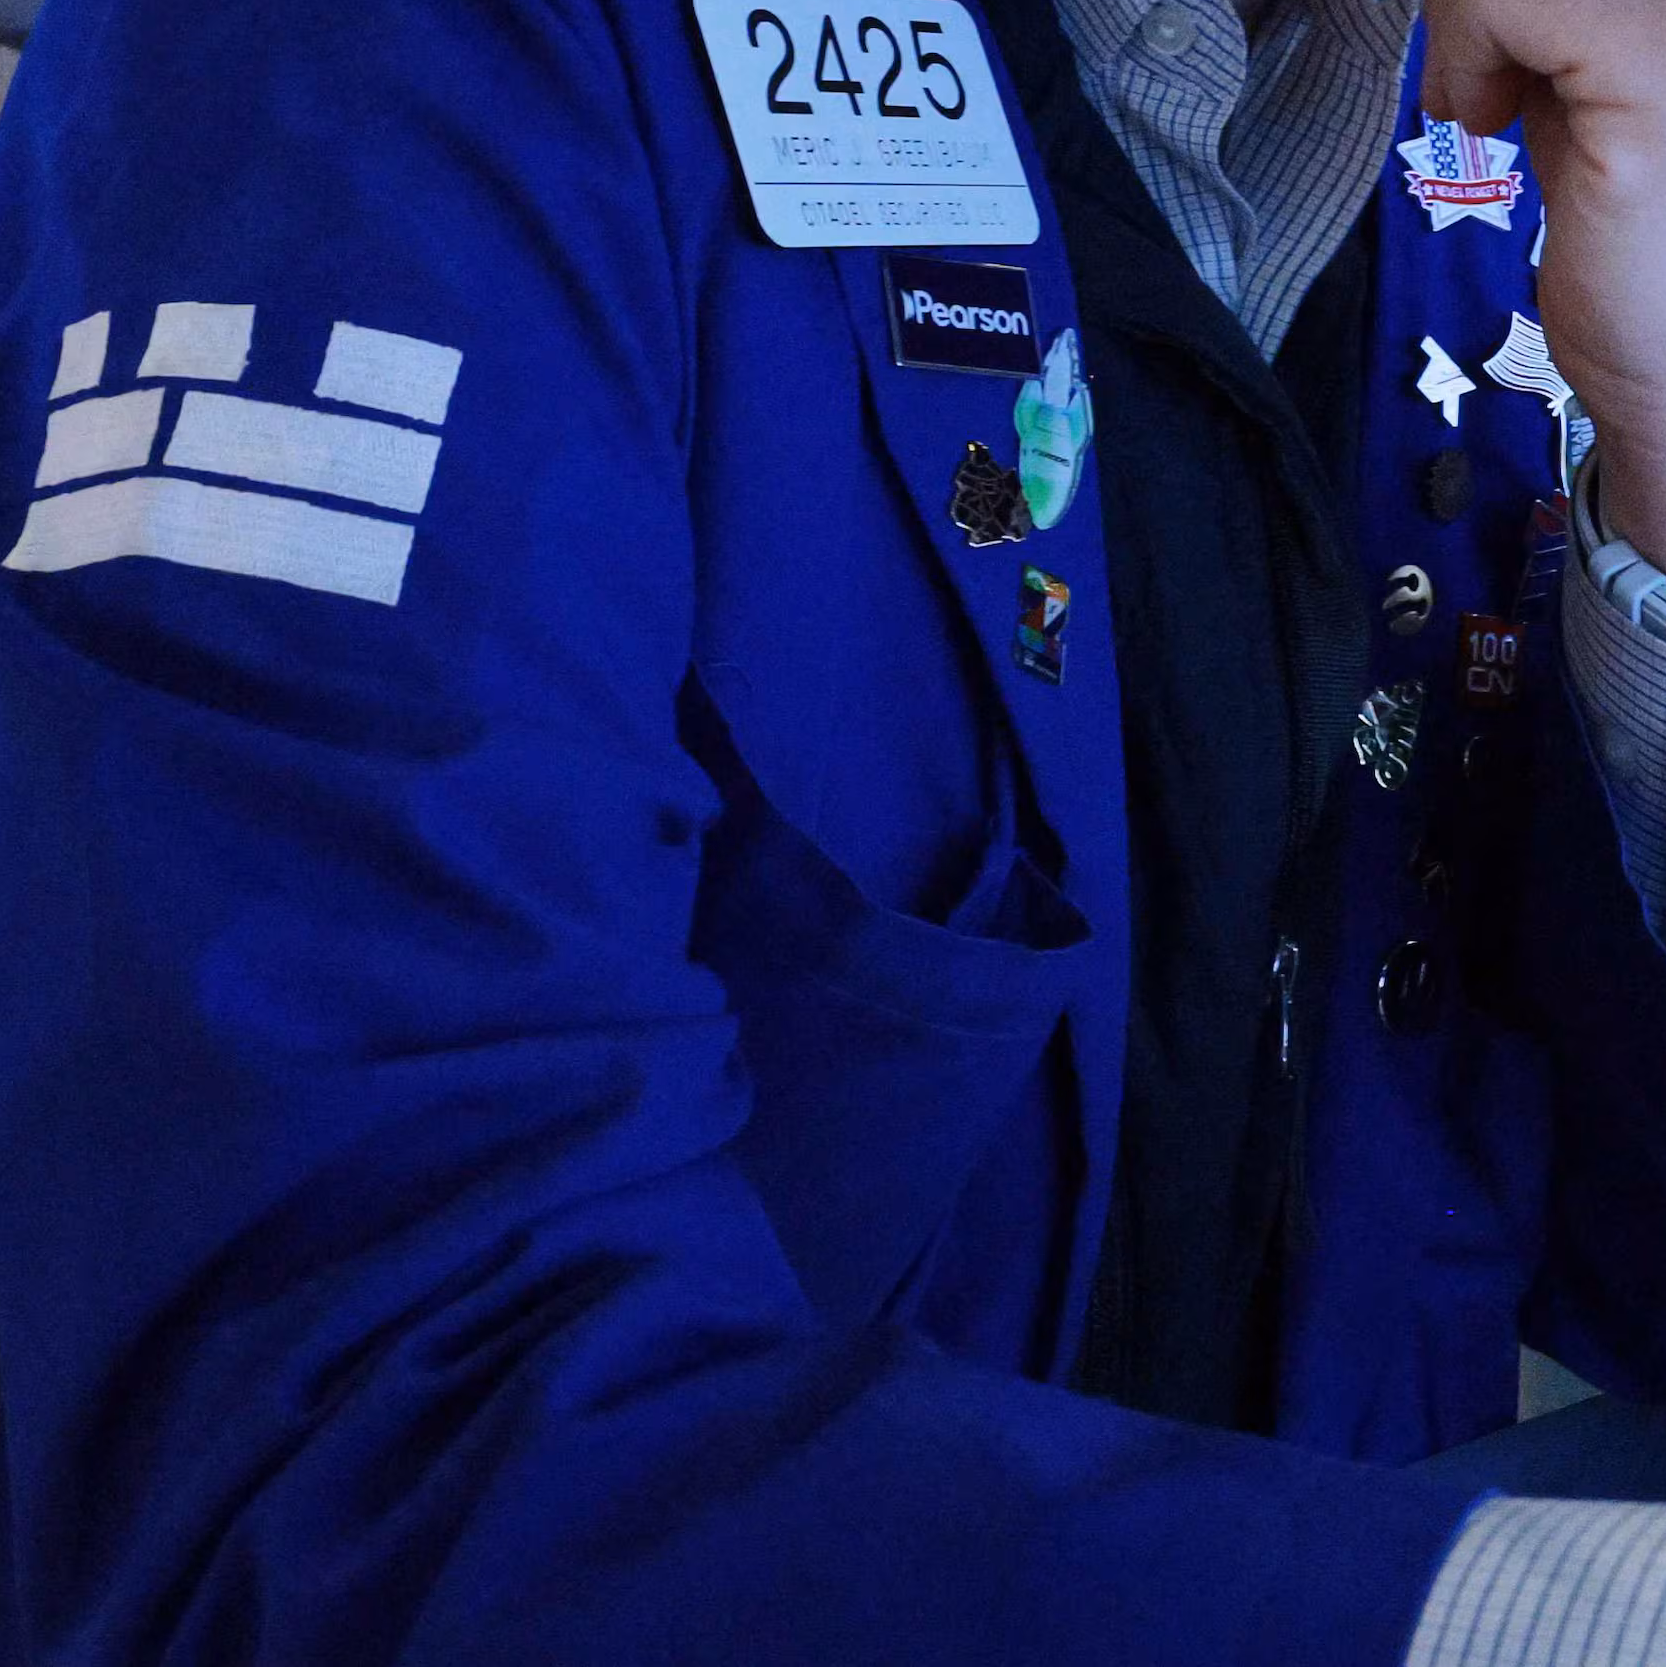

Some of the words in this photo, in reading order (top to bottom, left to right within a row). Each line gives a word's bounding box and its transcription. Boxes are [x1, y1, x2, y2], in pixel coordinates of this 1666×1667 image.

[747, 8, 966, 120] 2425
[914, 290, 1030, 336] Pearson
[1470, 631, 1517, 666] 100
